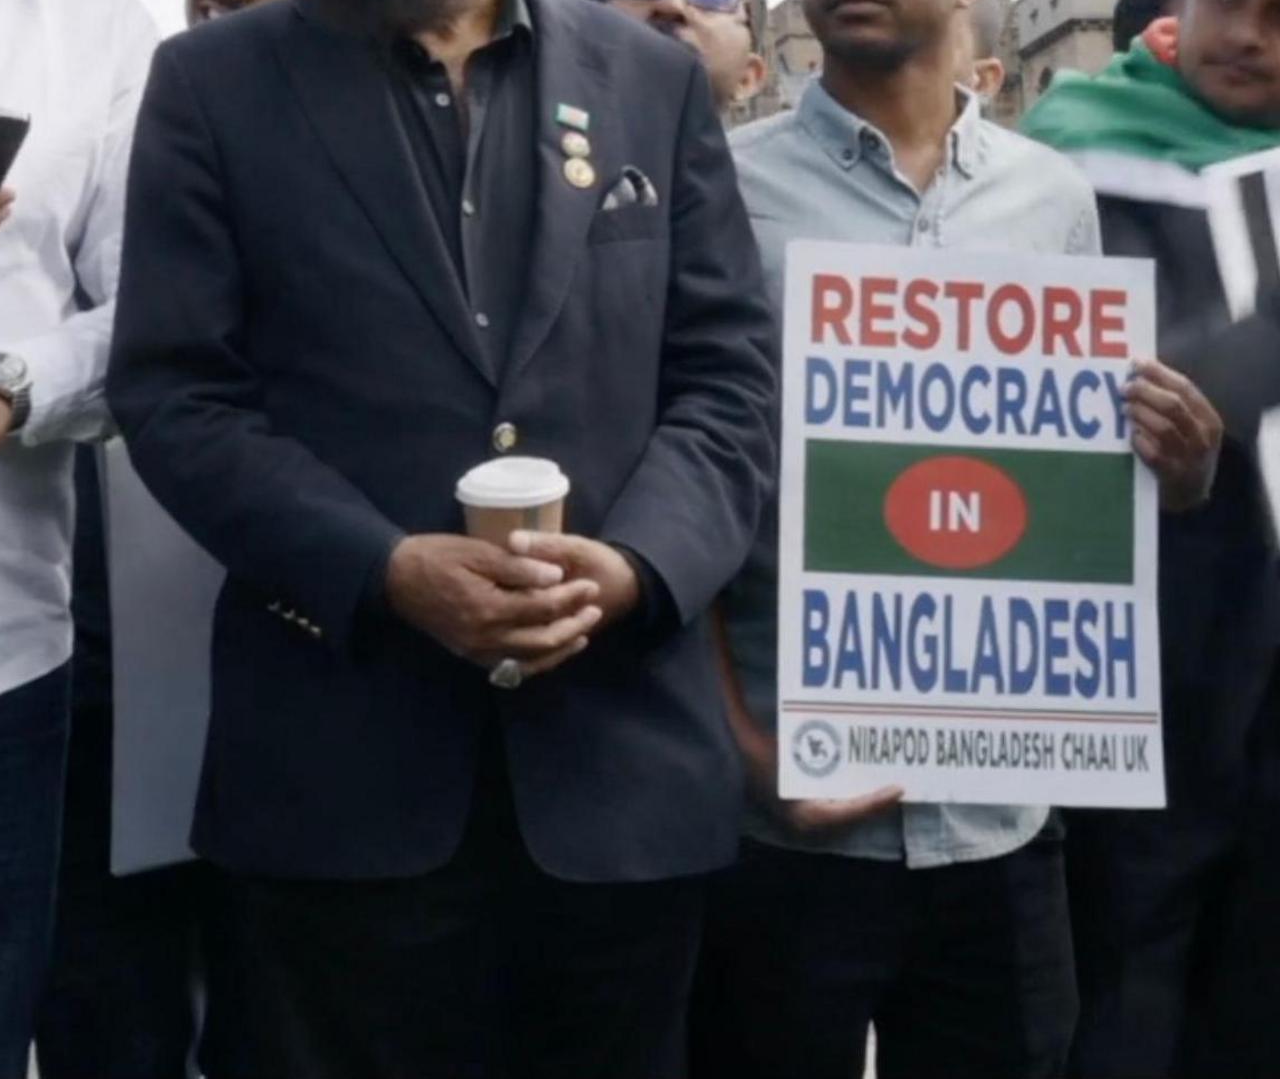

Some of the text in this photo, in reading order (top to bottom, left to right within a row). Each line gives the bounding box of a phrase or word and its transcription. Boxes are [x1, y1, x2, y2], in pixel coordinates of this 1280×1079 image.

[810, 273, 1129, 359] RESTORE
[804, 356, 1130, 440] DEMOCRACY
[928, 489, 981, 533] IN
[801, 588, 1137, 700] BANGLADESH
[847, 724, 929, 765] NIRAPOD
[936, 728, 1054, 771] BANGLADESH
[1060, 732, 1118, 772] CHAAI
[1124, 734, 1151, 772] UK
